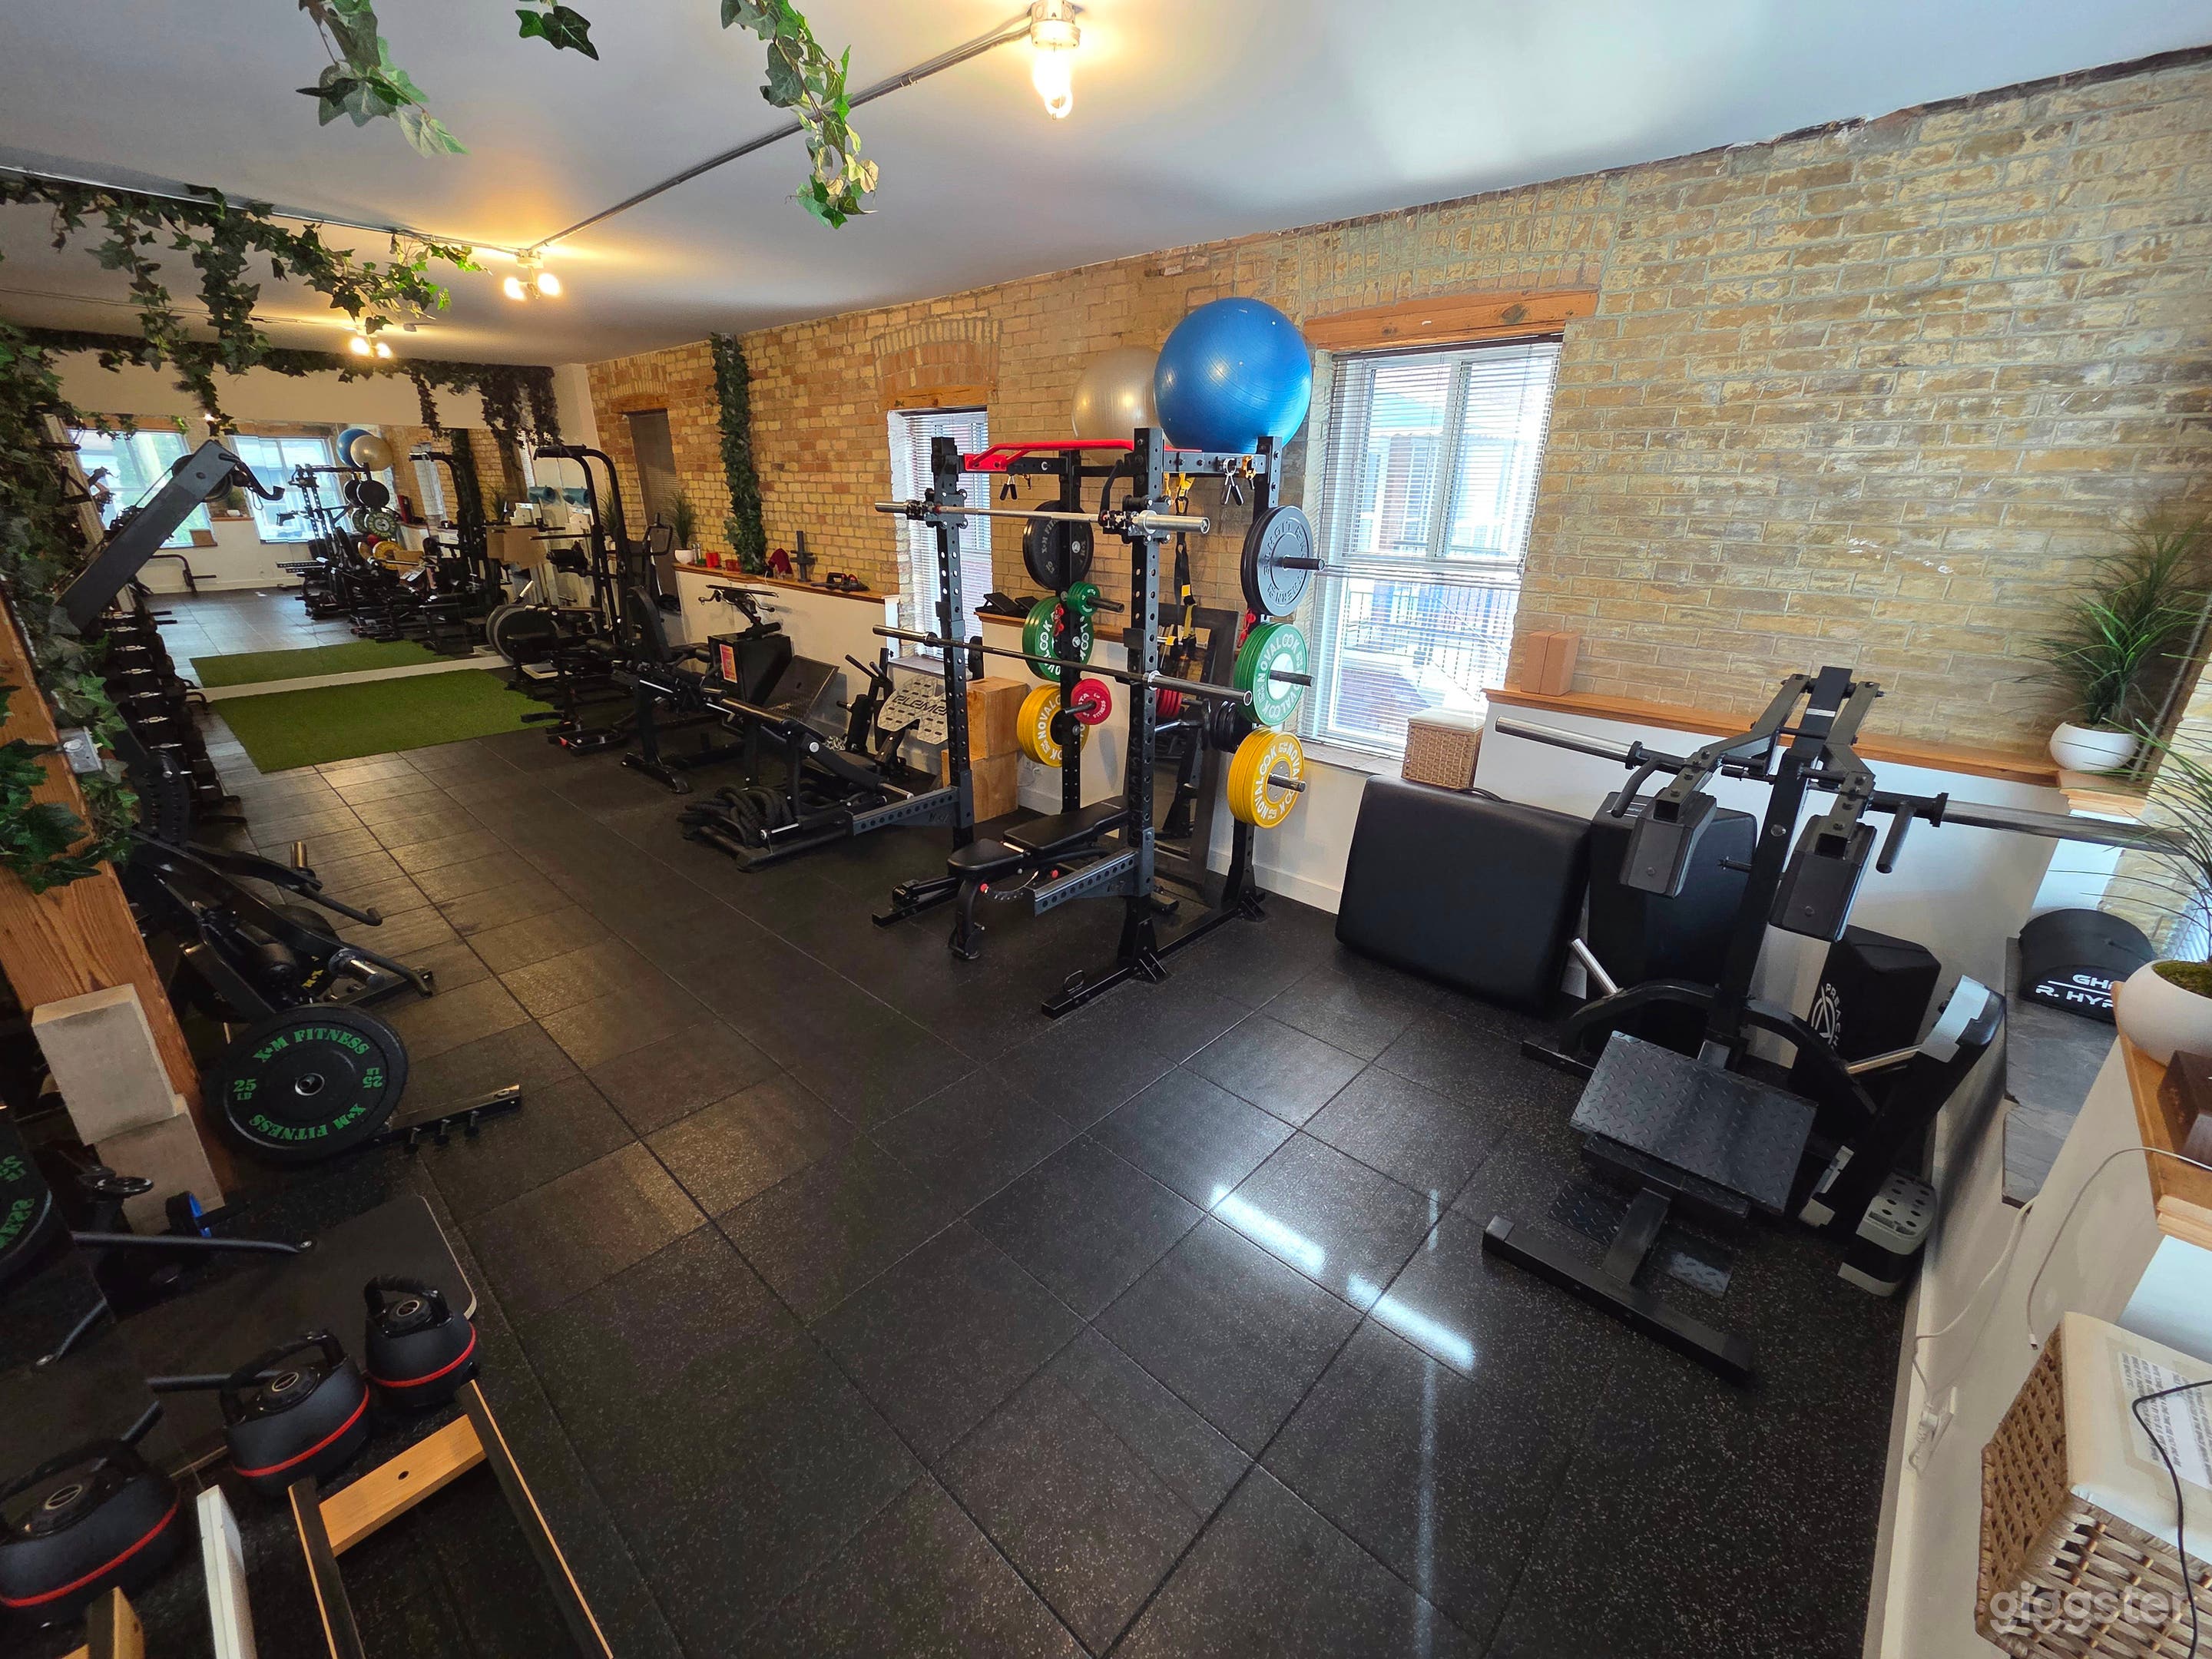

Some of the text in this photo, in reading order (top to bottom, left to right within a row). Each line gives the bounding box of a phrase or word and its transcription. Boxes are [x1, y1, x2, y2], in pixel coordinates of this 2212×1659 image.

[293, 1028, 370, 1055] FITNESS
[233, 1078, 257, 1092] 25
[249, 1114, 329, 1141] FITNESS
